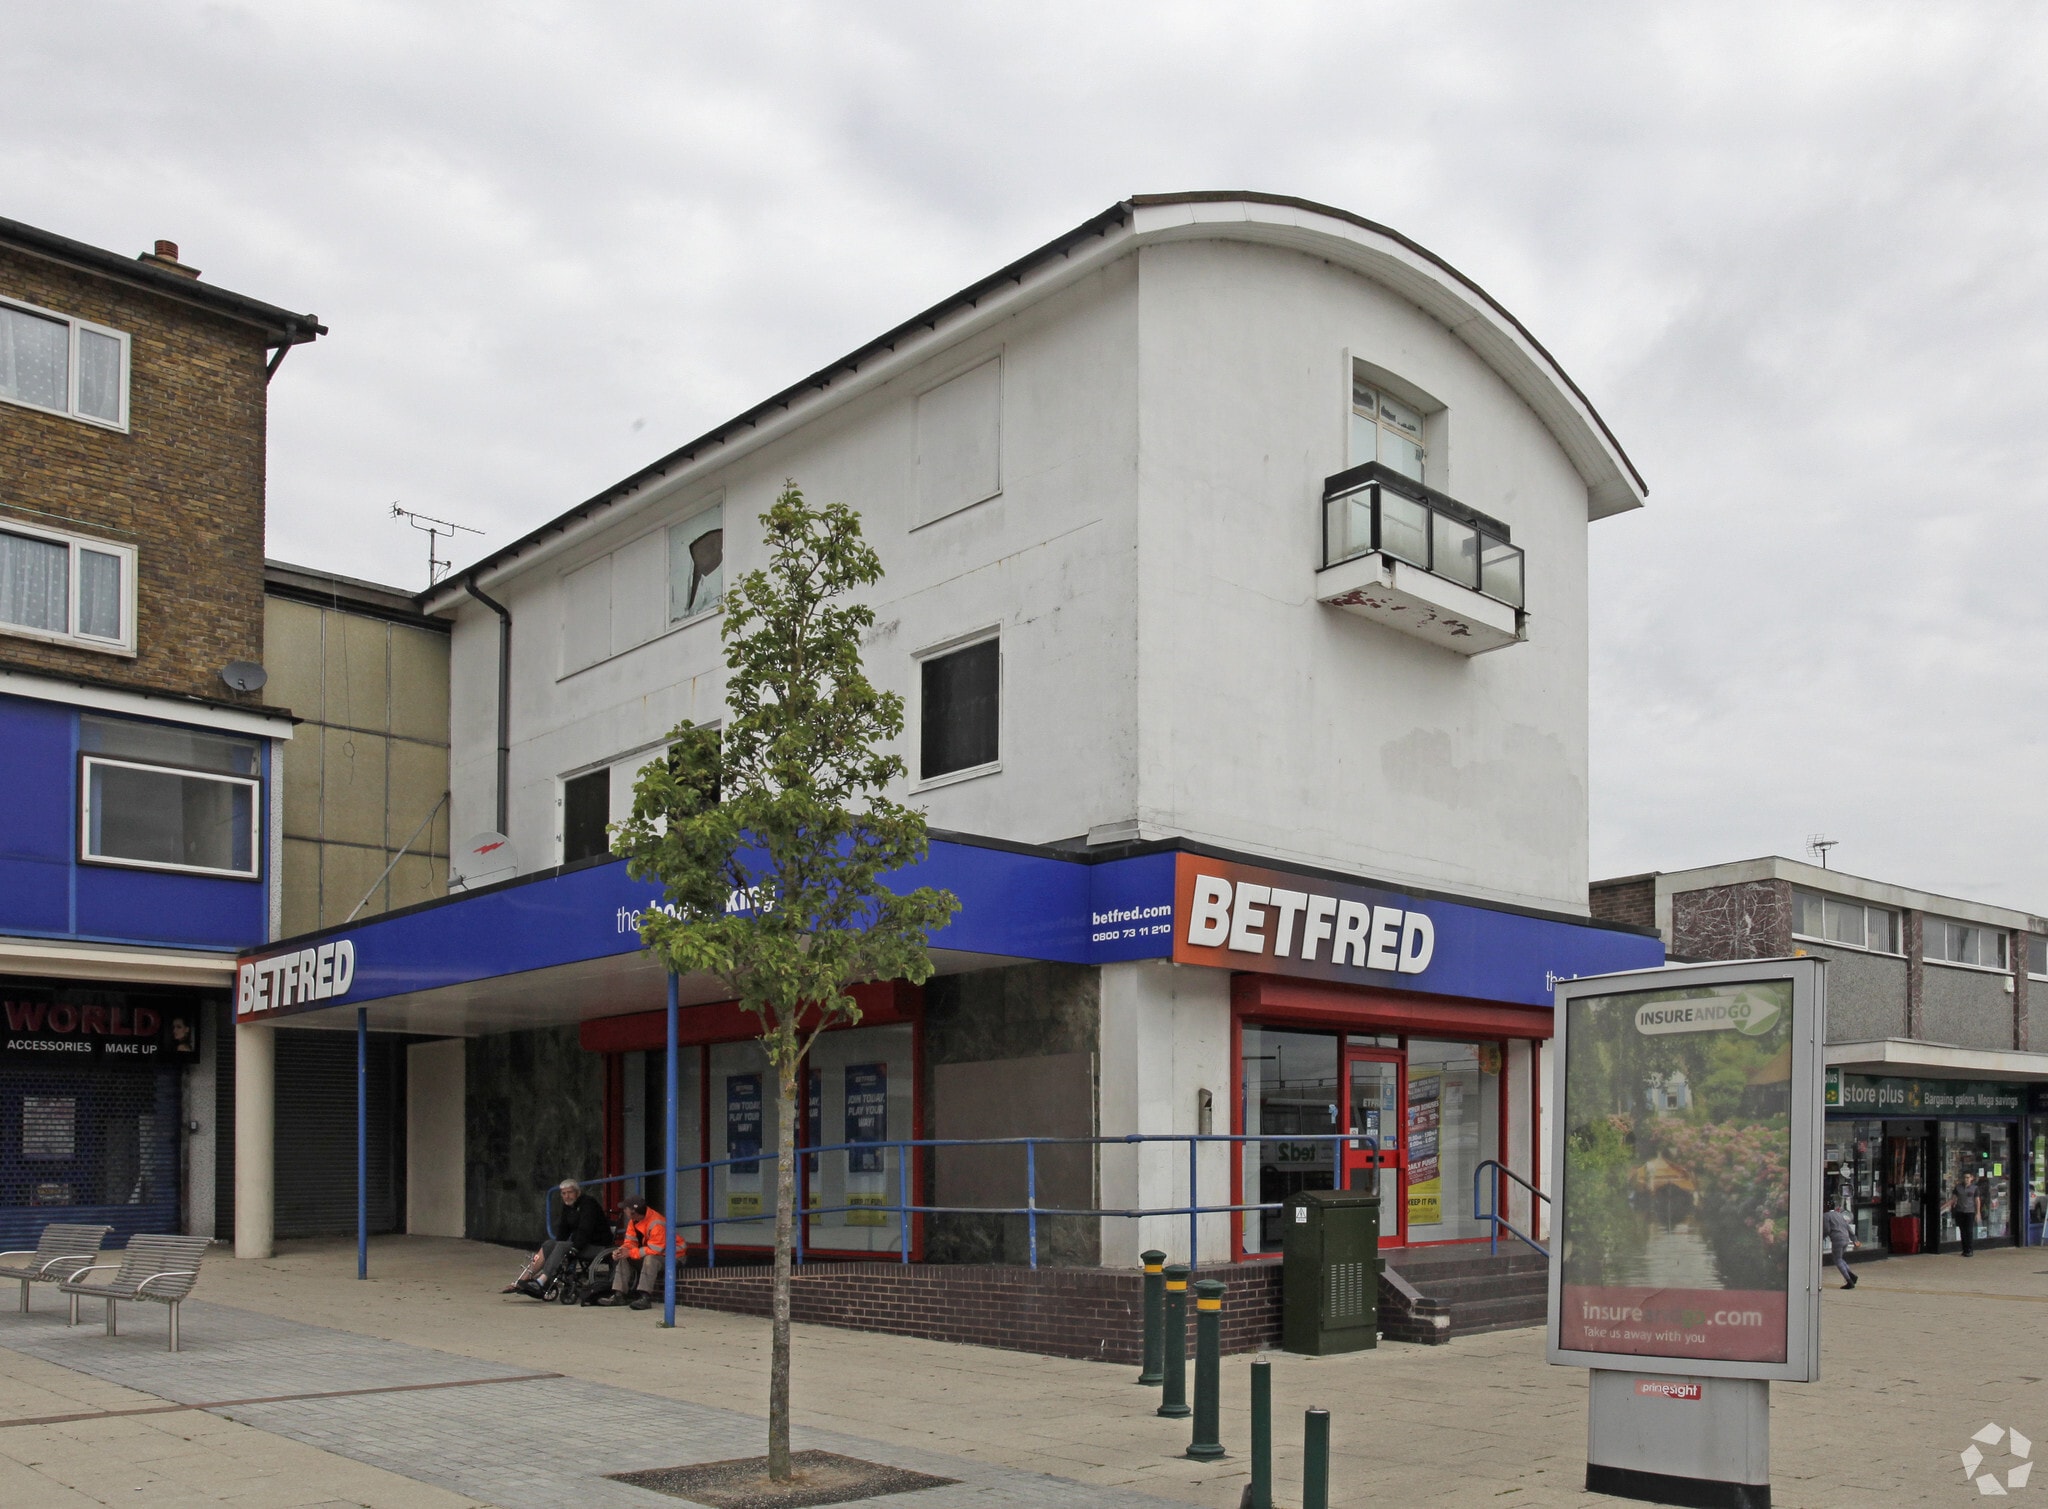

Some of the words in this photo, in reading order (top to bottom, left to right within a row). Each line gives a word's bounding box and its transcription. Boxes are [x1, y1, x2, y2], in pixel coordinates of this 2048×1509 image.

[617, 906, 641, 934] the
[1092, 905, 1171, 925] betfred.com
[1188, 874, 1435, 974] BETFRED
[1092, 931, 1120, 942] 0800
[1122, 928, 1136, 938] 73
[1139, 927, 1149, 936] 11
[1151, 924, 1171, 935] 210
[238, 939, 355, 1015] BETFRED
[1546, 970, 1566, 992] th
[4, 1001, 161, 1037] WORLD
[1640, 1003, 1751, 1026] INSUREANDGO
[7, 1039, 92, 1052] ACCESSORIES
[105, 1043, 139, 1054] MAKE
[142, 1045, 158, 1055] UP
[1844, 1083, 1876, 1103] store
[1879, 1084, 1904, 1108] plus
[1924, 1092, 1953, 1108] Bargains
[1955, 1093, 1977, 1108] galore,
[1978, 1094, 1994, 1108] Mega
[1995, 1095, 2019, 1109] savings
[1421, 1198, 1427, 1206] IT
[1427, 1198, 1437, 1206] FUN
[1584, 1326, 1607, 1338] Take
[1610, 1328, 1621, 1339] us
[1624, 1331, 1652, 1342] away
[1655, 1330, 1682, 1342] with
[1685, 1334, 1706, 1344] you
